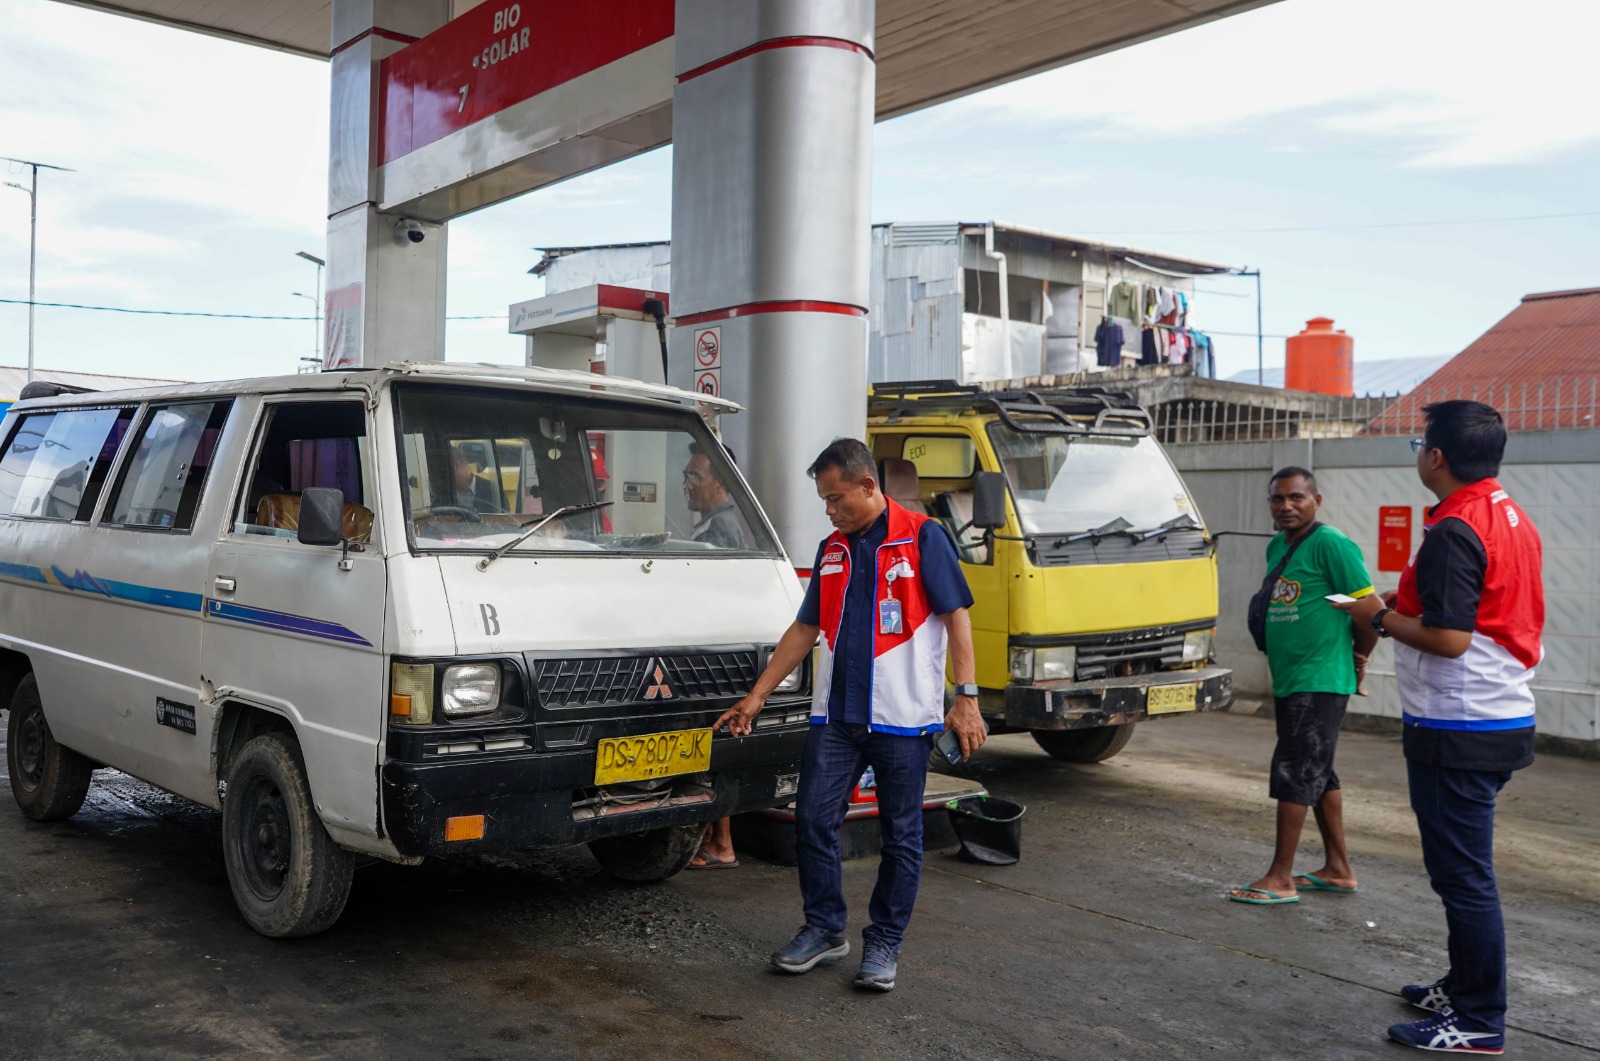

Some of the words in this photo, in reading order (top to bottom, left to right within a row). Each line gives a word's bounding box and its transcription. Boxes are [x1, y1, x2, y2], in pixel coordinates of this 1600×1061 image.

[493, 3, 521, 34] BIO
[481, 26, 531, 70] SOLAR
[458, 84, 469, 113] 7
[527, 307, 553, 320] PERTAMINA
[479, 603, 501, 636] B
[602, 741, 629, 769] DS
[634, 735, 679, 764] 7807
[680, 731, 709, 759] JK
